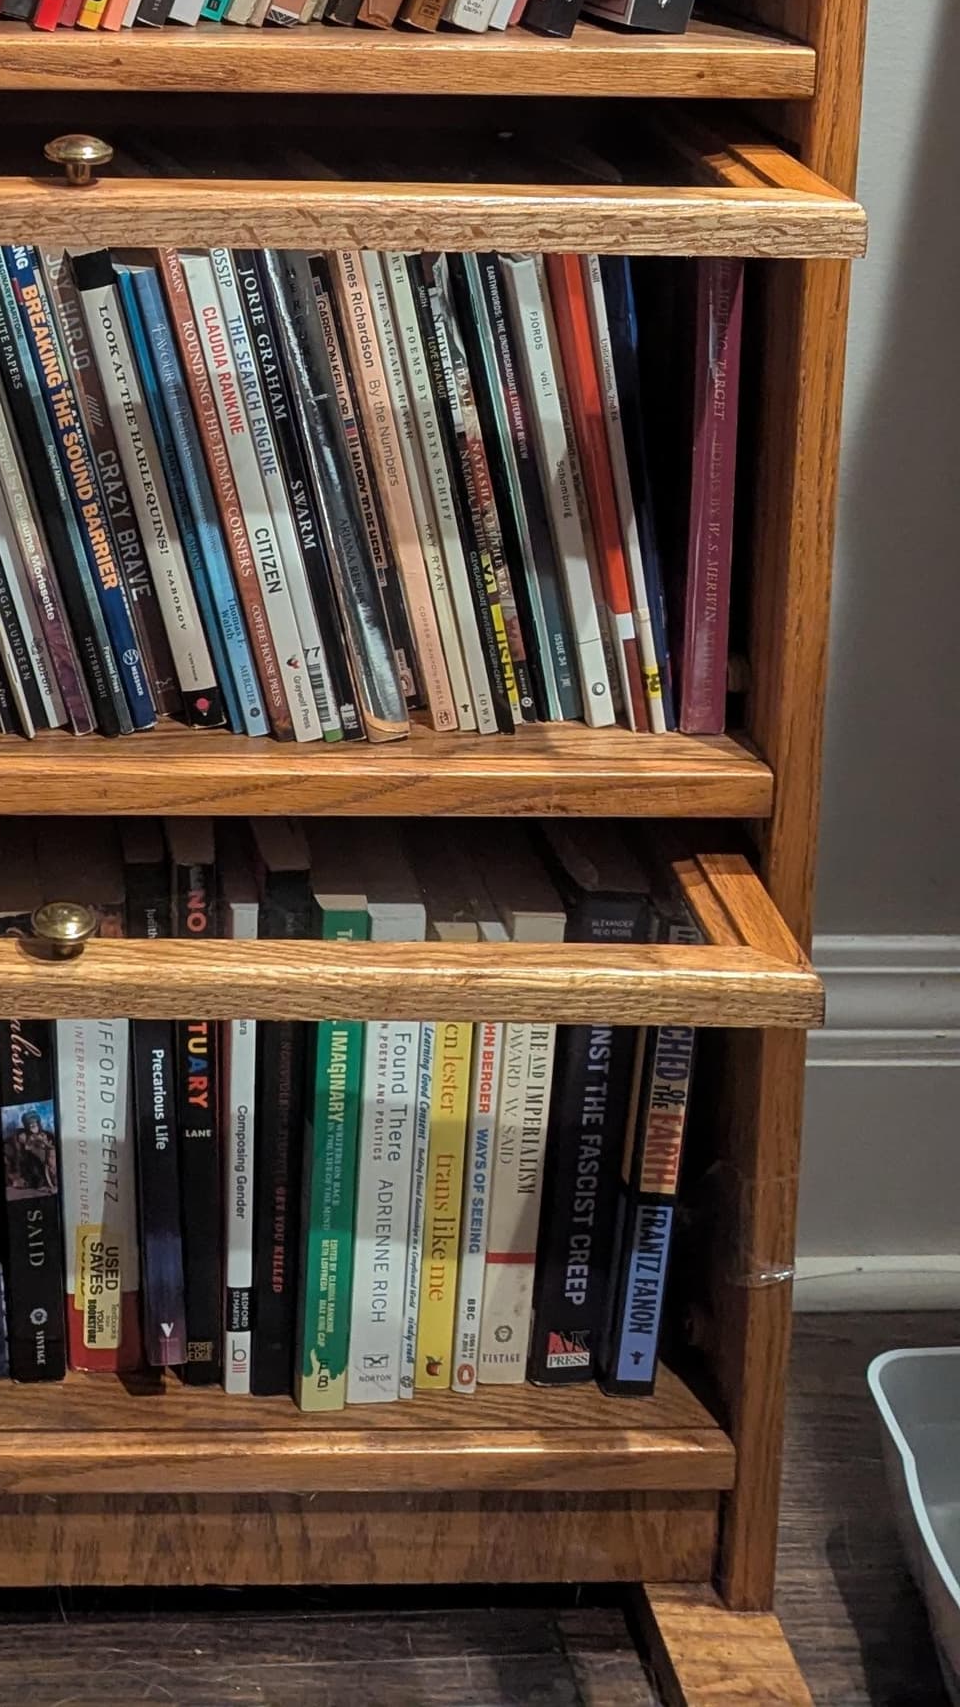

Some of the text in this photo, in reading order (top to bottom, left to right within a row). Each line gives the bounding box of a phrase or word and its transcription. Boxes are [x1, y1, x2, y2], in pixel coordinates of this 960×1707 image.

[202, 305, 244, 436] CLAUDIA RANKINE
[228, 314, 278, 477] THE SEARCH ENGINE
[239, 267, 287, 420] JORIE GRAHAM
[23, 283, 118, 590] BREAKING THE SOUND BARRIER
[254, 527, 282, 595] CITIZEN
[289, 479, 317, 551] SWARM
[151, 1048, 167, 1151] Precarious Life
[185, 1128, 213, 1139] LANE
[389, 1032, 412, 1162] Found There
[234, 1104, 249, 1220] Composing Gender
[468, 1128, 489, 1255] WAYS OF SEEING
[26, 1209, 44, 1268] SAID
[370, 1179, 393, 1324] ADRIENNE RICH
[466, 1297, 477, 1321] BBC
[548, 1354, 588, 1368] PRESS
[628, 1278, 659, 1335] FANON
